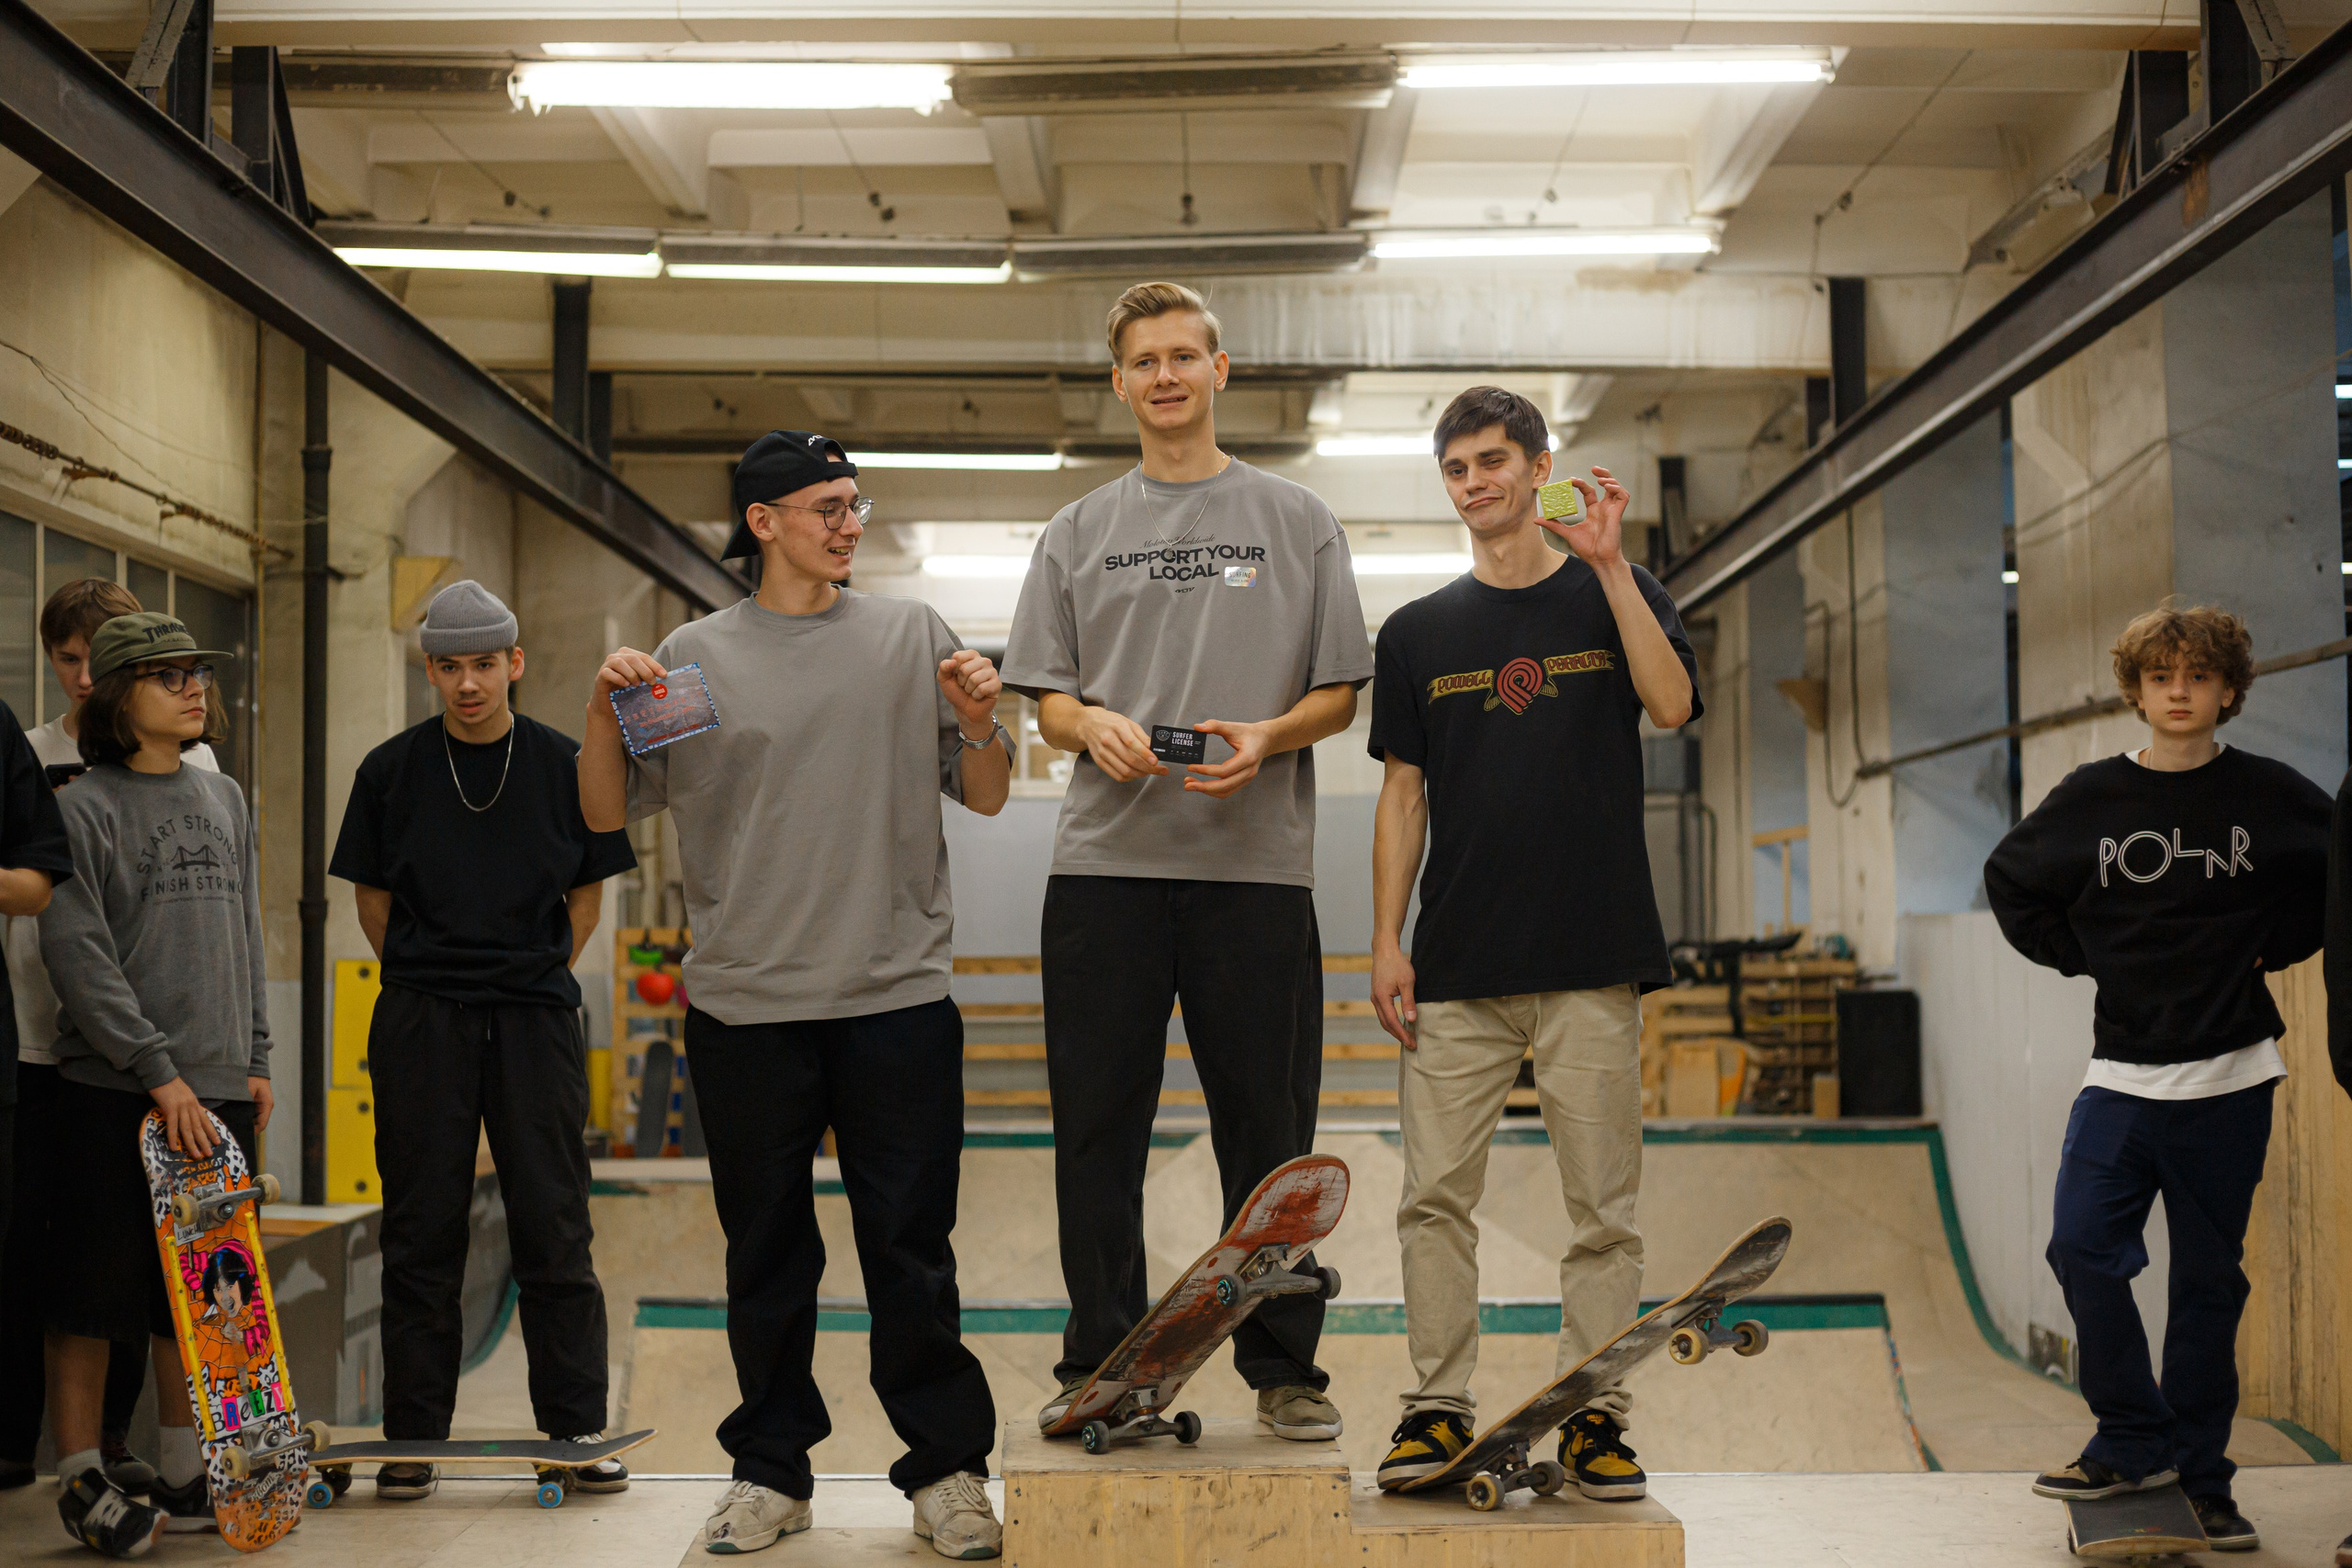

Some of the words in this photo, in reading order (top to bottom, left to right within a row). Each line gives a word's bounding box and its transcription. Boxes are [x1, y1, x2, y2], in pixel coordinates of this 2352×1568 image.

[1104, 547, 1204, 570] SUPPORT
[1205, 545, 1266, 562] YOUR
[1149, 563, 1219, 581] LOCAL
[1171, 738, 1194, 747] LICENSE
[1172, 731, 1193, 739] SURFER
[137, 818, 176, 874] START
[2099, 826, 2254, 887] POLAR
[141, 876, 189, 902] FINISH
